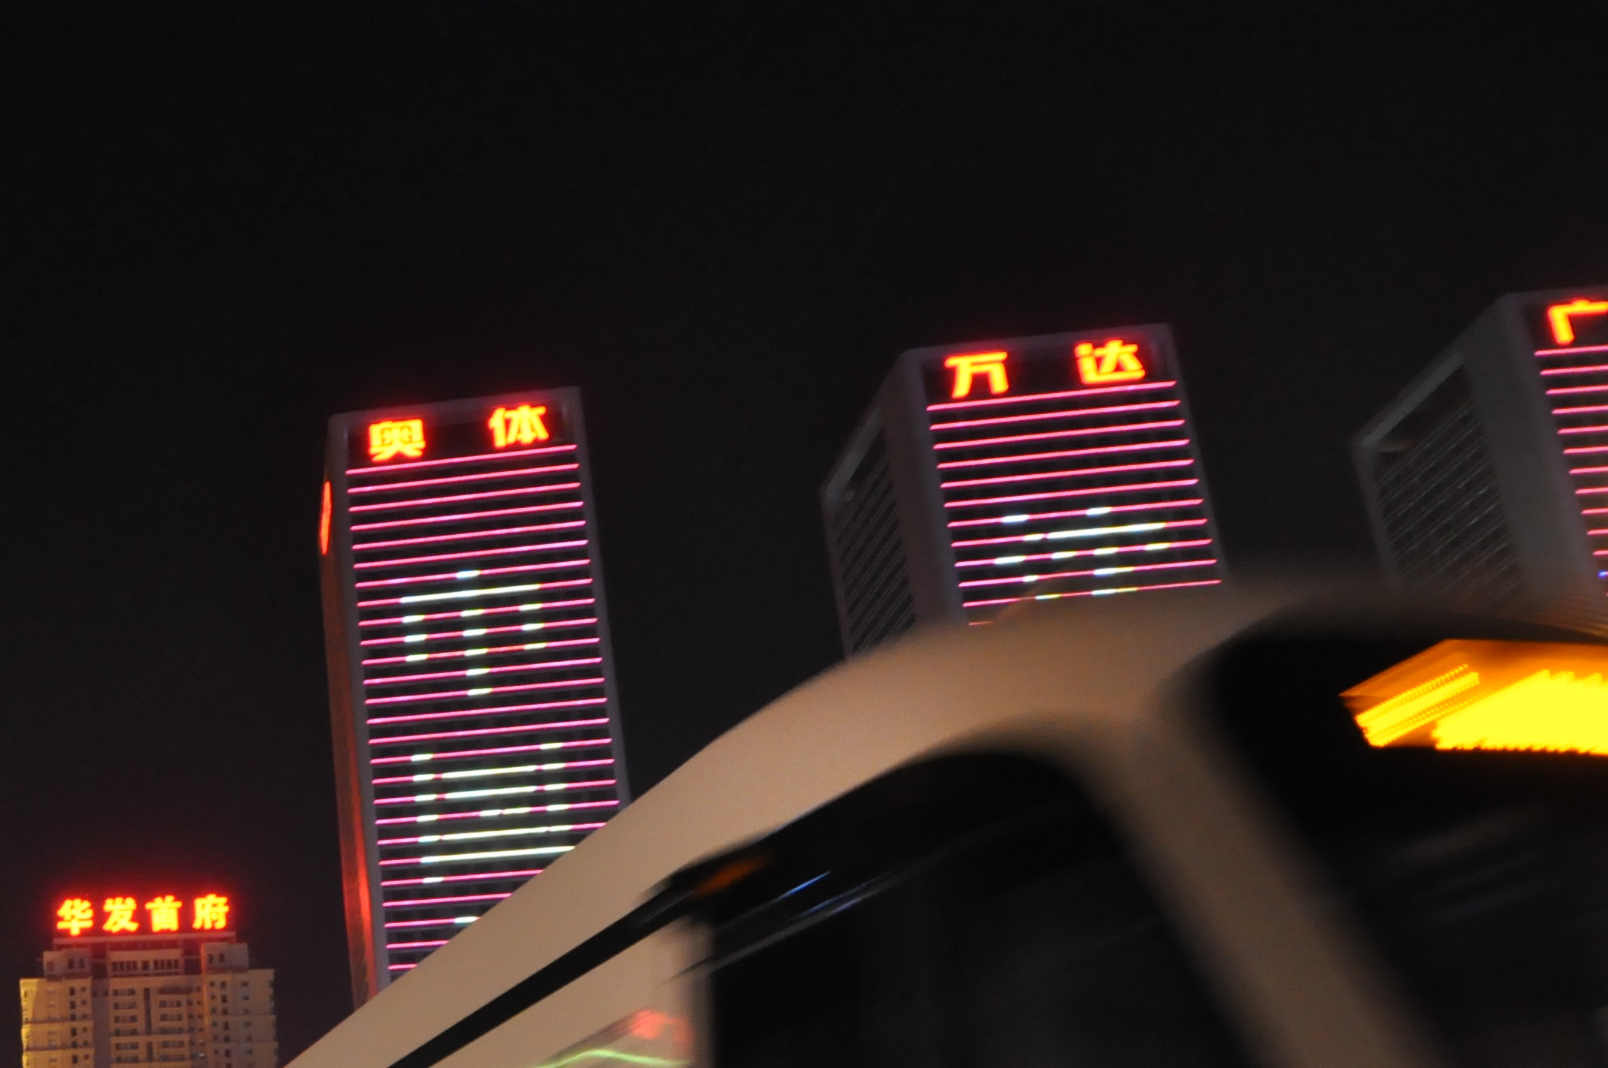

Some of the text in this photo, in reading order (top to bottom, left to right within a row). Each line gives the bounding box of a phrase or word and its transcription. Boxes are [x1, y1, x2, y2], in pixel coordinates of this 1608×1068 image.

[943, 339, 1147, 399] 万达
[368, 403, 550, 463] 奥体
[55, 893, 230, 936] 华发首府
